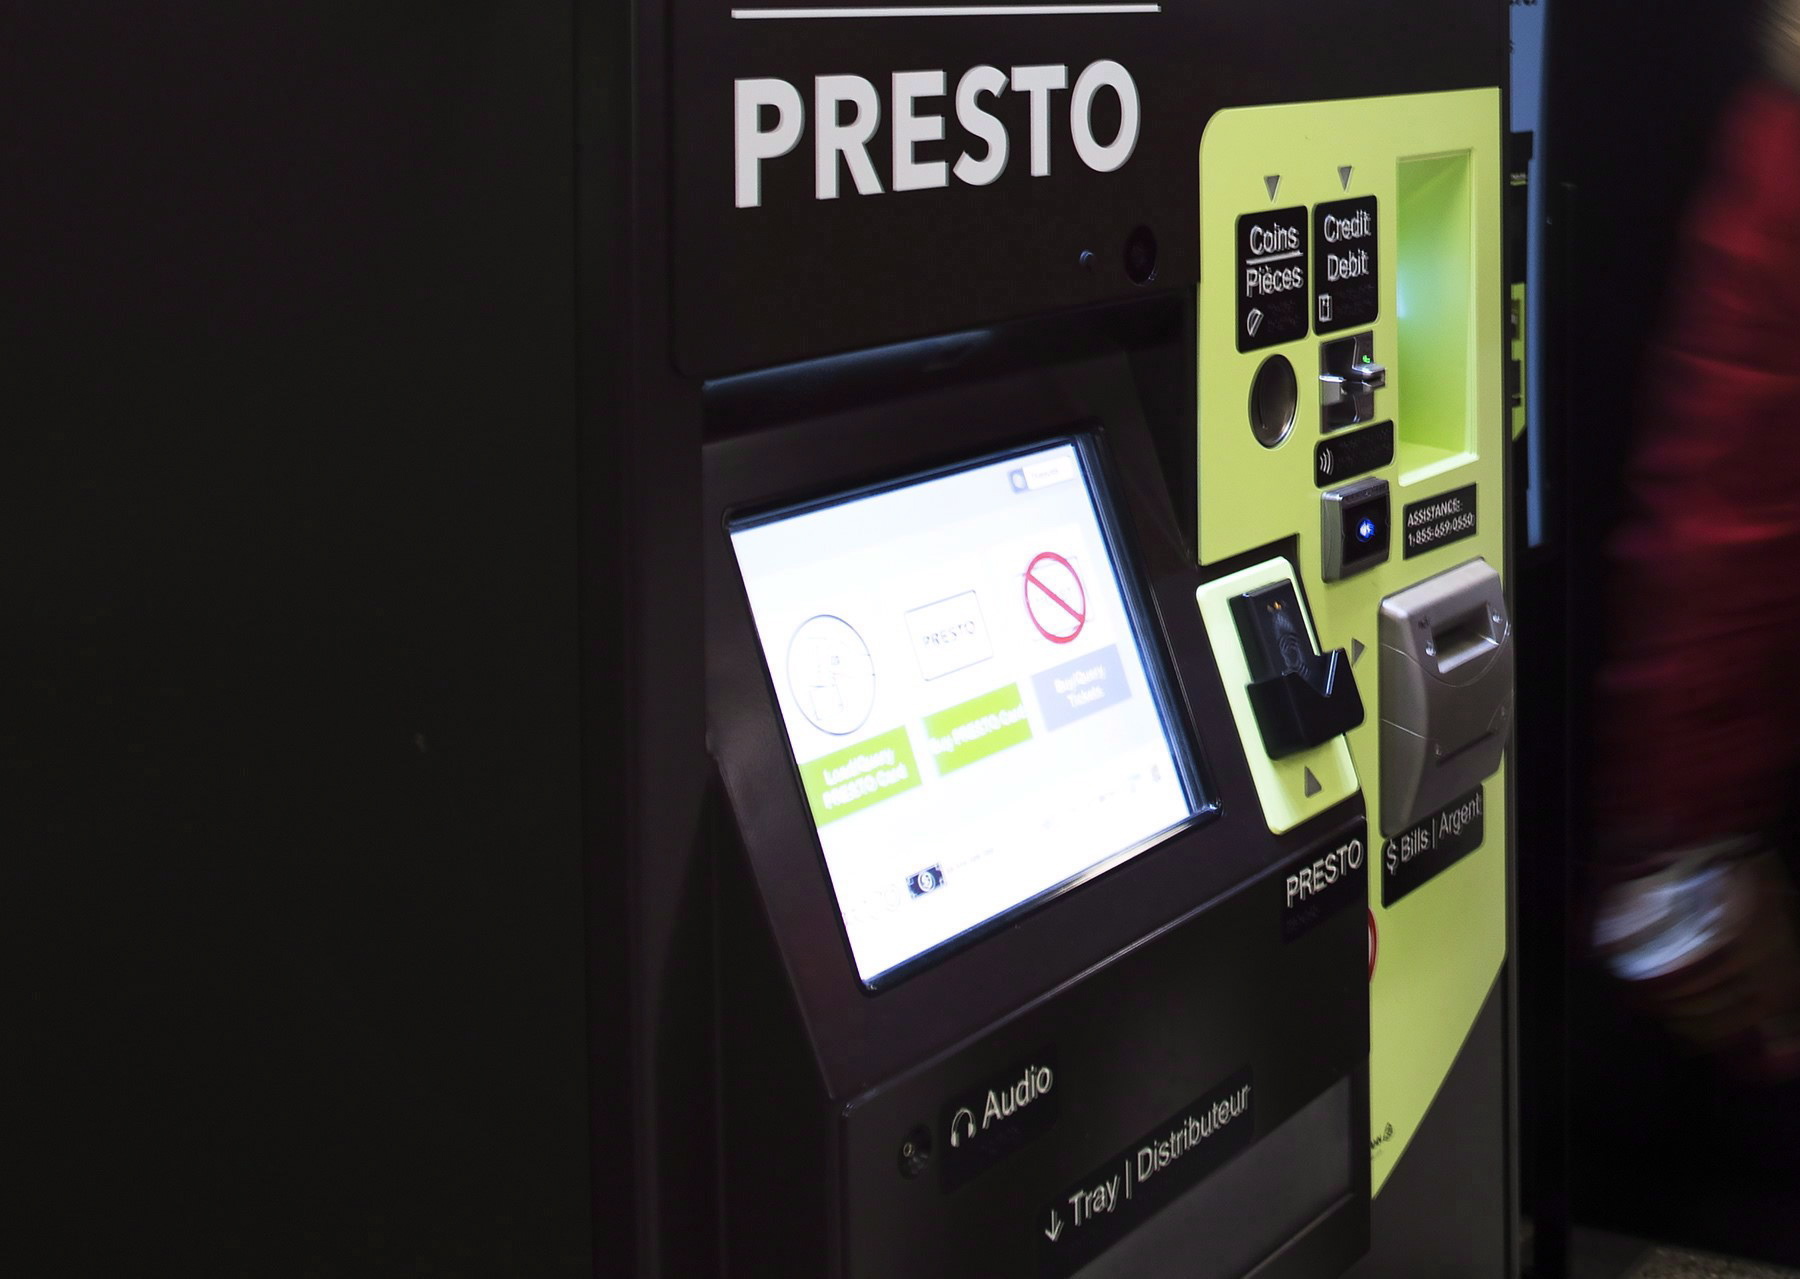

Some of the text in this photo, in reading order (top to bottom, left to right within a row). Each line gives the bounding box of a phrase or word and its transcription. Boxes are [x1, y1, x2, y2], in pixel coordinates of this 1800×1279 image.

[734, 60, 1141, 208] PRESTO
[1250, 222, 1300, 256] Coins
[1324, 210, 1371, 243] Credit
[1246, 266, 1304, 297] Pièces
[1327, 248, 1369, 282] Debit
[1401, 827, 1430, 863] Bills
[1439, 792, 1482, 840] Argent
[1286, 839, 1364, 908] PRESTO
[982, 1065, 1053, 1129] Audio
[1069, 1084, 1251, 1227] Tray Distributeur
